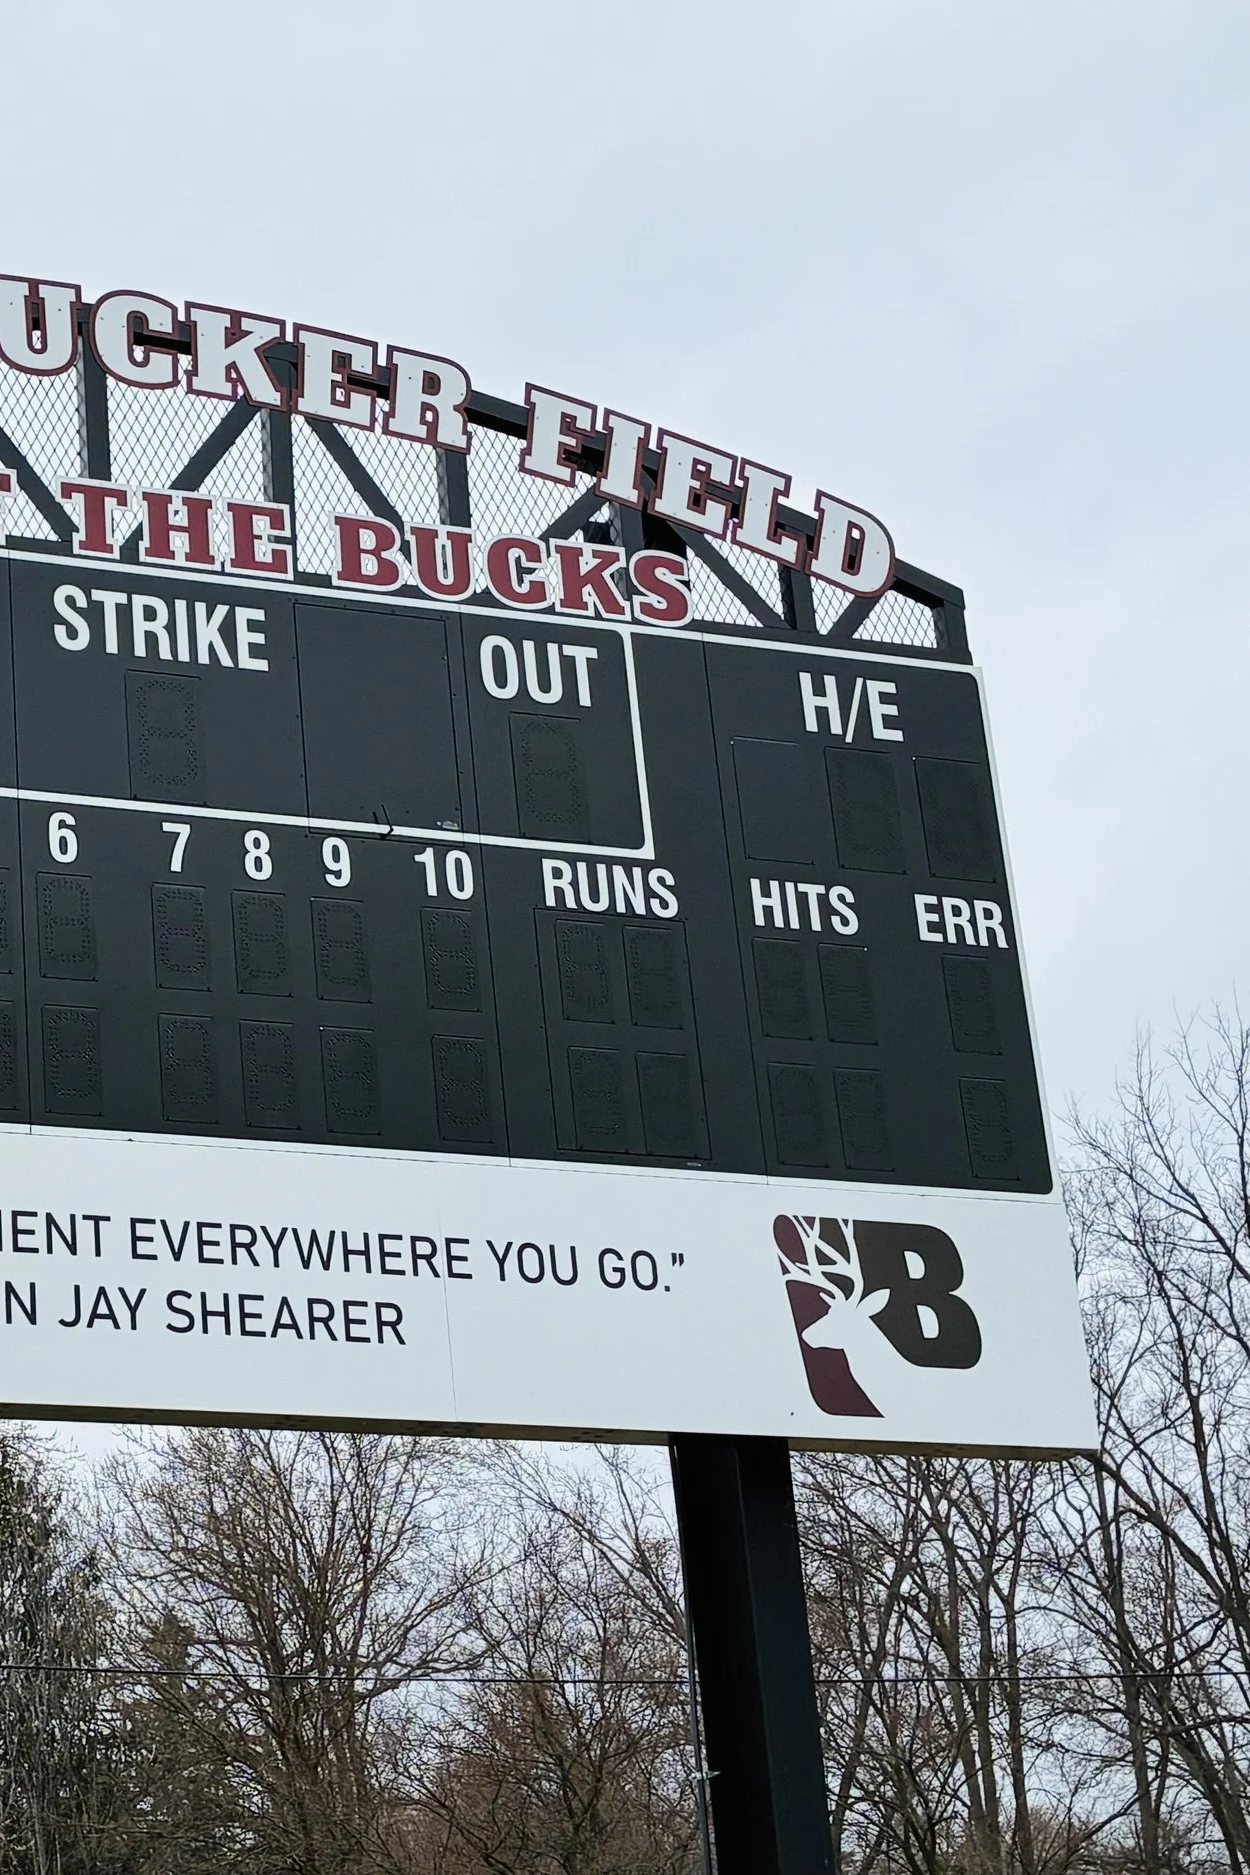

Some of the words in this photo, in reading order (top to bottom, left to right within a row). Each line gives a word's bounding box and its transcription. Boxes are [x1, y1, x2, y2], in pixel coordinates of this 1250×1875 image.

[518, 382, 895, 598] FIELD
[56, 478, 294, 581] THE
[330, 511, 694, 627] BUCKS
[54, 584, 268, 671] STRIKE
[480, 635, 598, 706] OUT
[799, 672, 903, 742] H/E
[49, 812, 77, 862] 6
[162, 822, 190, 872] 7
[245, 830, 272, 880] 8
[323, 837, 350, 886] 9
[415, 848, 473, 899] 10
[542, 859, 678, 918] RUNS
[750, 878, 858, 935] HITS
[915, 893, 1009, 949] ERR
[130, 1218, 472, 1279] EVERYWHERE
[486, 1240, 578, 1285] YOU
[599, 1248, 684, 1292] GO.”
[59, 1285, 146, 1330] JAY
[166, 1290, 406, 1345] SHEARER
